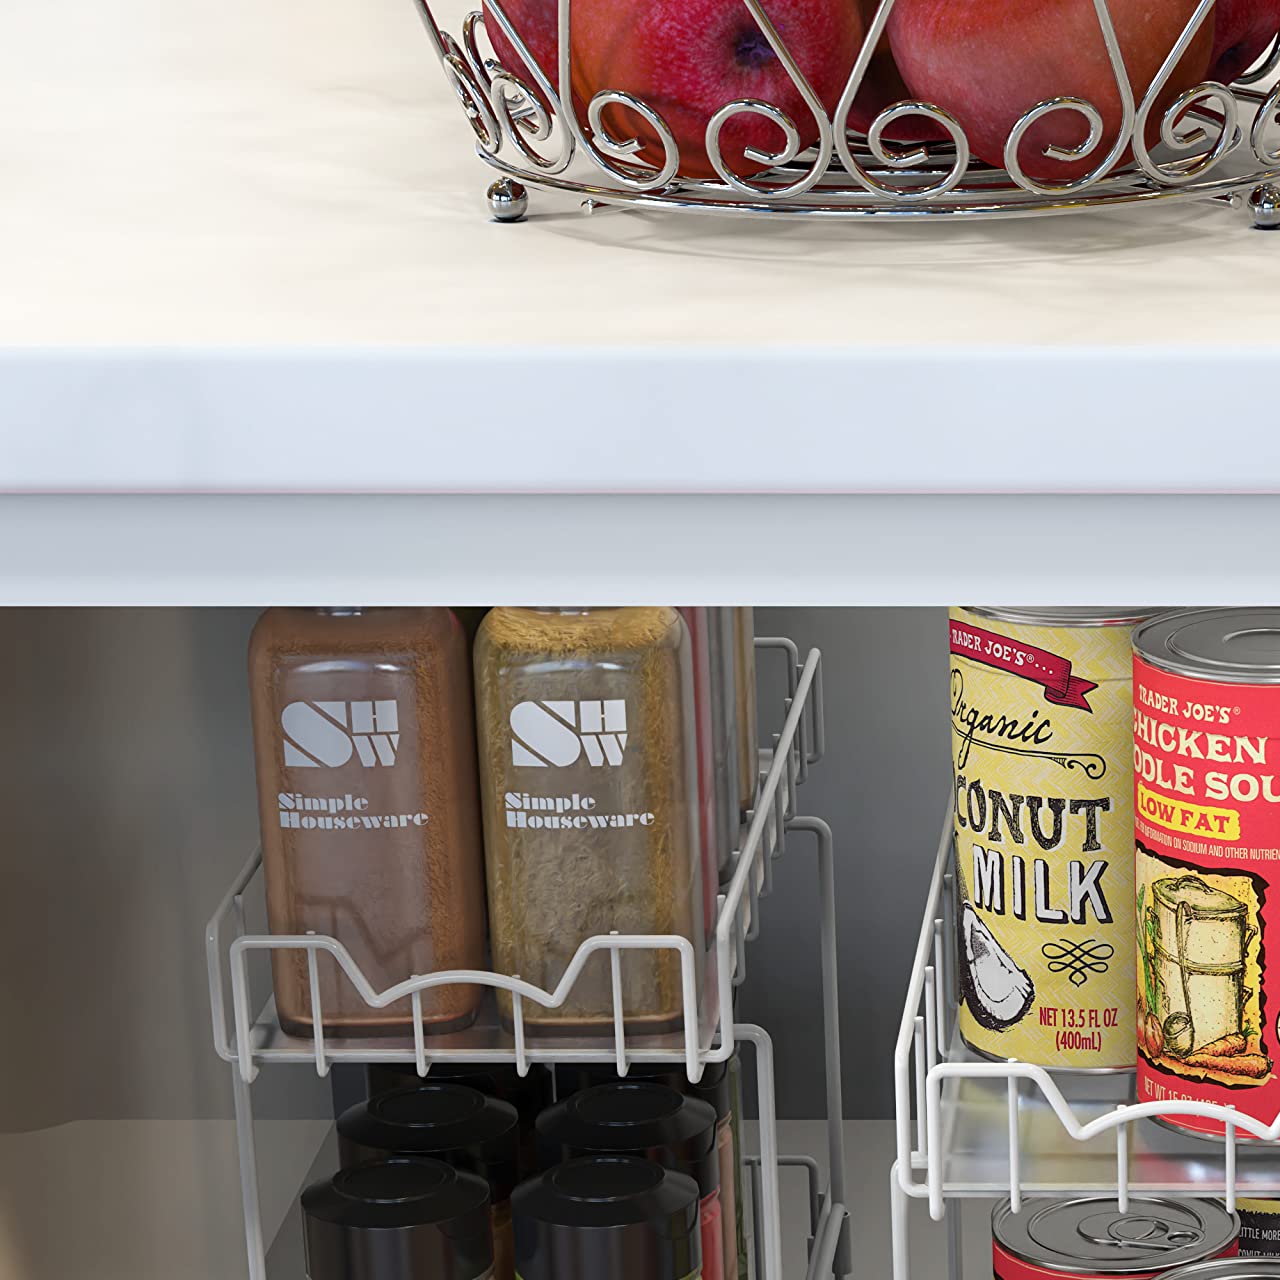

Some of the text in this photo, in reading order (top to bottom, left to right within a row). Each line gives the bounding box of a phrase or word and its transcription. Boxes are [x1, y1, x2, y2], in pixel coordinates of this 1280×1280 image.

[1138, 684, 1179, 716] TRADER
[278, 792, 369, 814] Simple
[504, 792, 596, 814] Simple
[953, 772, 1111, 852] CONUT
[1140, 792, 1231, 834] LOW FAT
[279, 809, 430, 831] Houseware
[505, 809, 656, 831] Houseware
[1182, 839, 1207, 855] SODIUM
[1208, 844, 1223, 859] AND
[1224, 845, 1248, 860] OTHER
[972, 843, 1114, 925] MILK
[1039, 1006, 1118, 1028] NET 13.5 FL OZ
[1055, 1030, 1102, 1052] (400mL)
[1261, 1228, 1280, 1241] MORE
